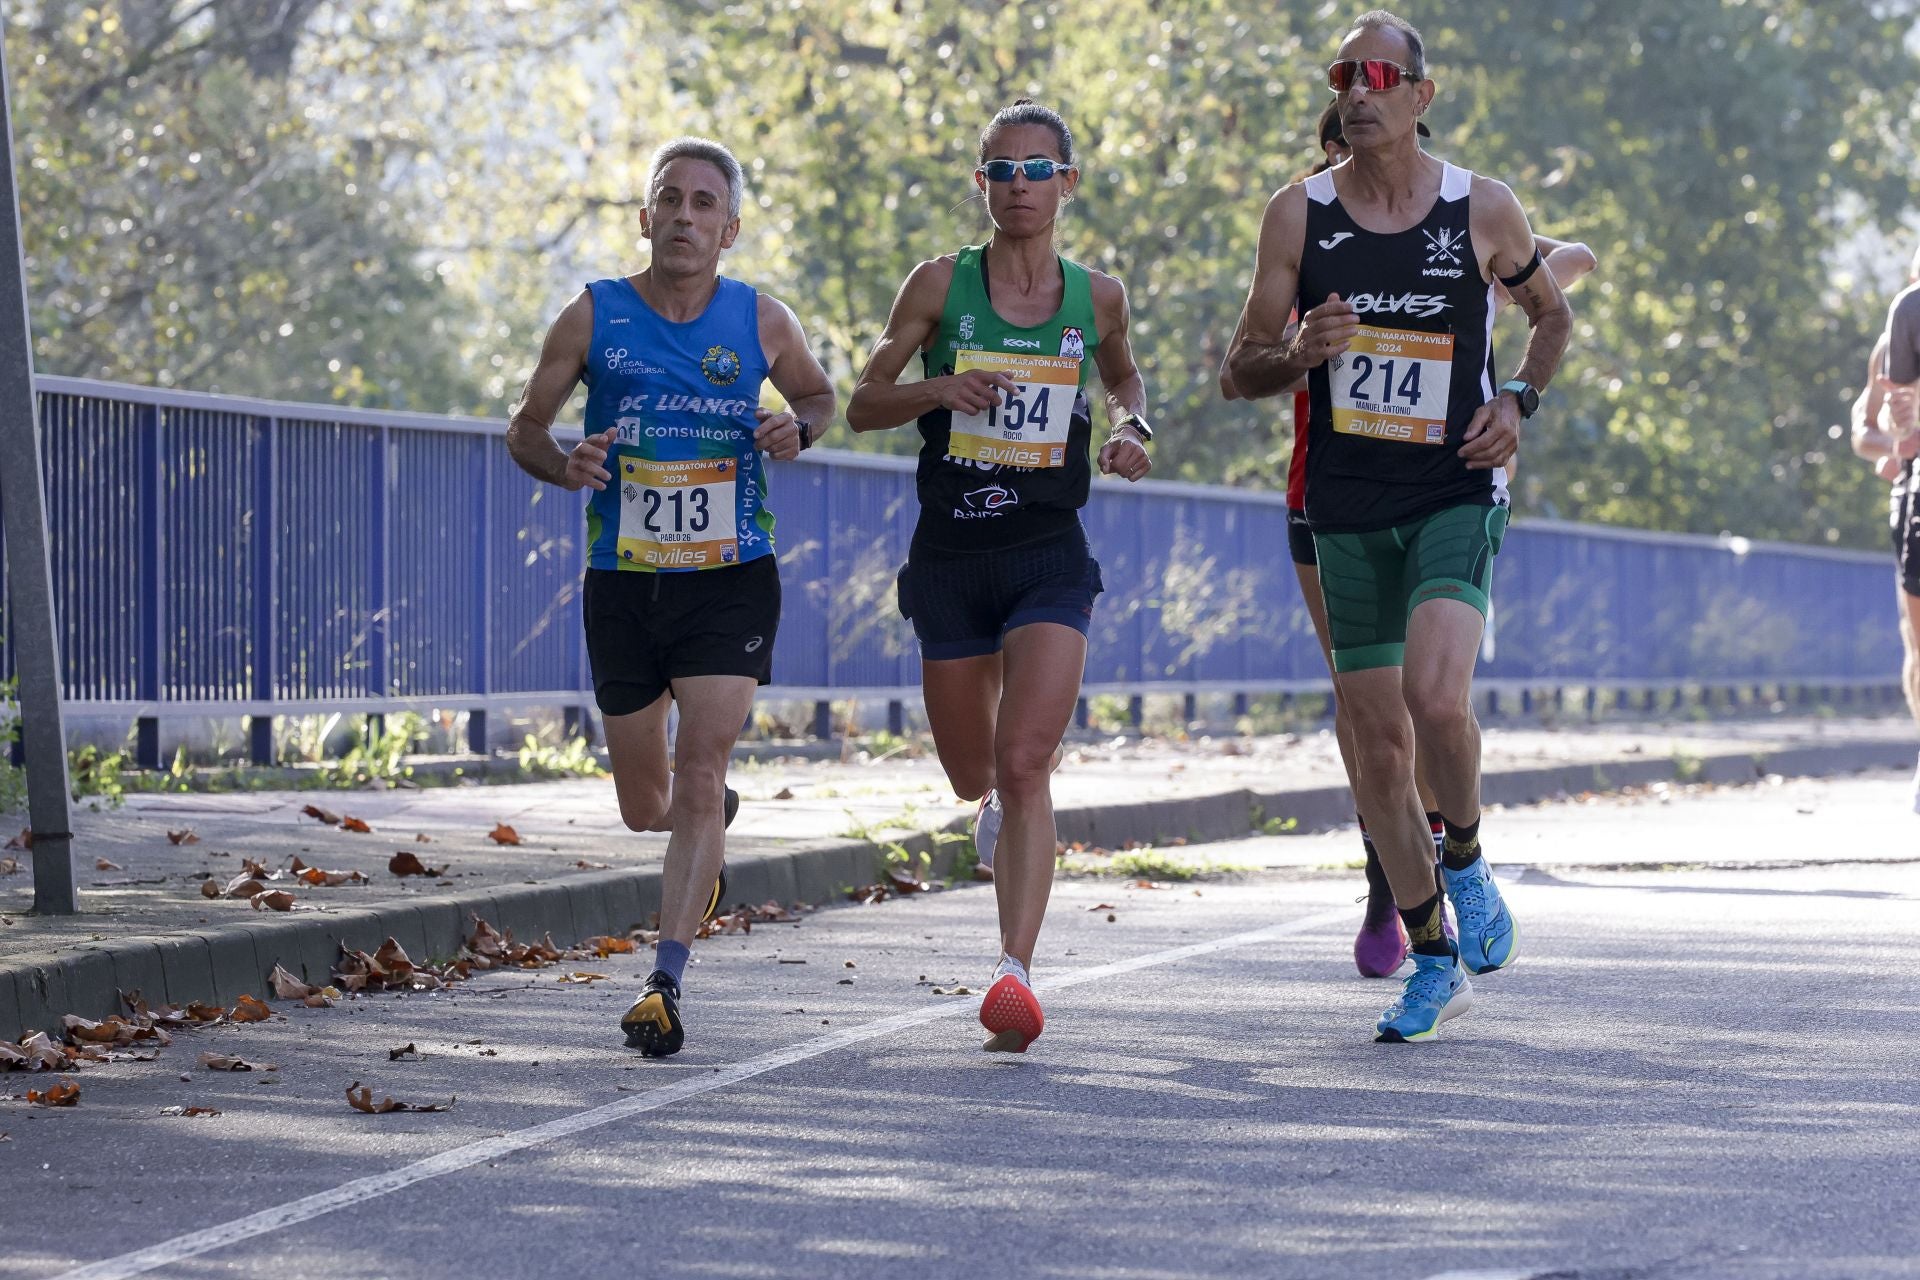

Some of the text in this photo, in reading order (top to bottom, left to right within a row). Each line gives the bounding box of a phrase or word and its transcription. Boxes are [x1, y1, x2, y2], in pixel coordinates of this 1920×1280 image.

[1422, 268, 1465, 279] WOLVES
[1381, 331, 1423, 343] MARATÓN
[1424, 335, 1451, 346] AVILÉS
[1376, 343, 1402, 353] 2024
[619, 360, 645, 369] LEGAL
[983, 355, 1009, 365] MEDIA
[1010, 355, 1051, 367] MARATÓN
[1051, 358, 1077, 369] AVILÉS
[620, 368, 667, 376] CONCURSAL
[1005, 369, 1031, 379] 024
[1350, 355, 1421, 406] 214
[617, 395, 748, 416] DC LUANCO
[988, 384, 1050, 431] 154
[1355, 401, 1411, 416] MANUEL ANTONIO
[1349, 418, 1414, 439] avilés
[1003, 431, 1022, 441] ROCIO
[977, 446, 1042, 465] avilés
[643, 462, 665, 472] MEDIA
[666, 460, 707, 472] MARATÓN
[662, 474, 689, 484] 2024
[643, 487, 709, 532] 213
[660, 533, 691, 542] PABLO 26
[644, 548, 707, 564] avilés
